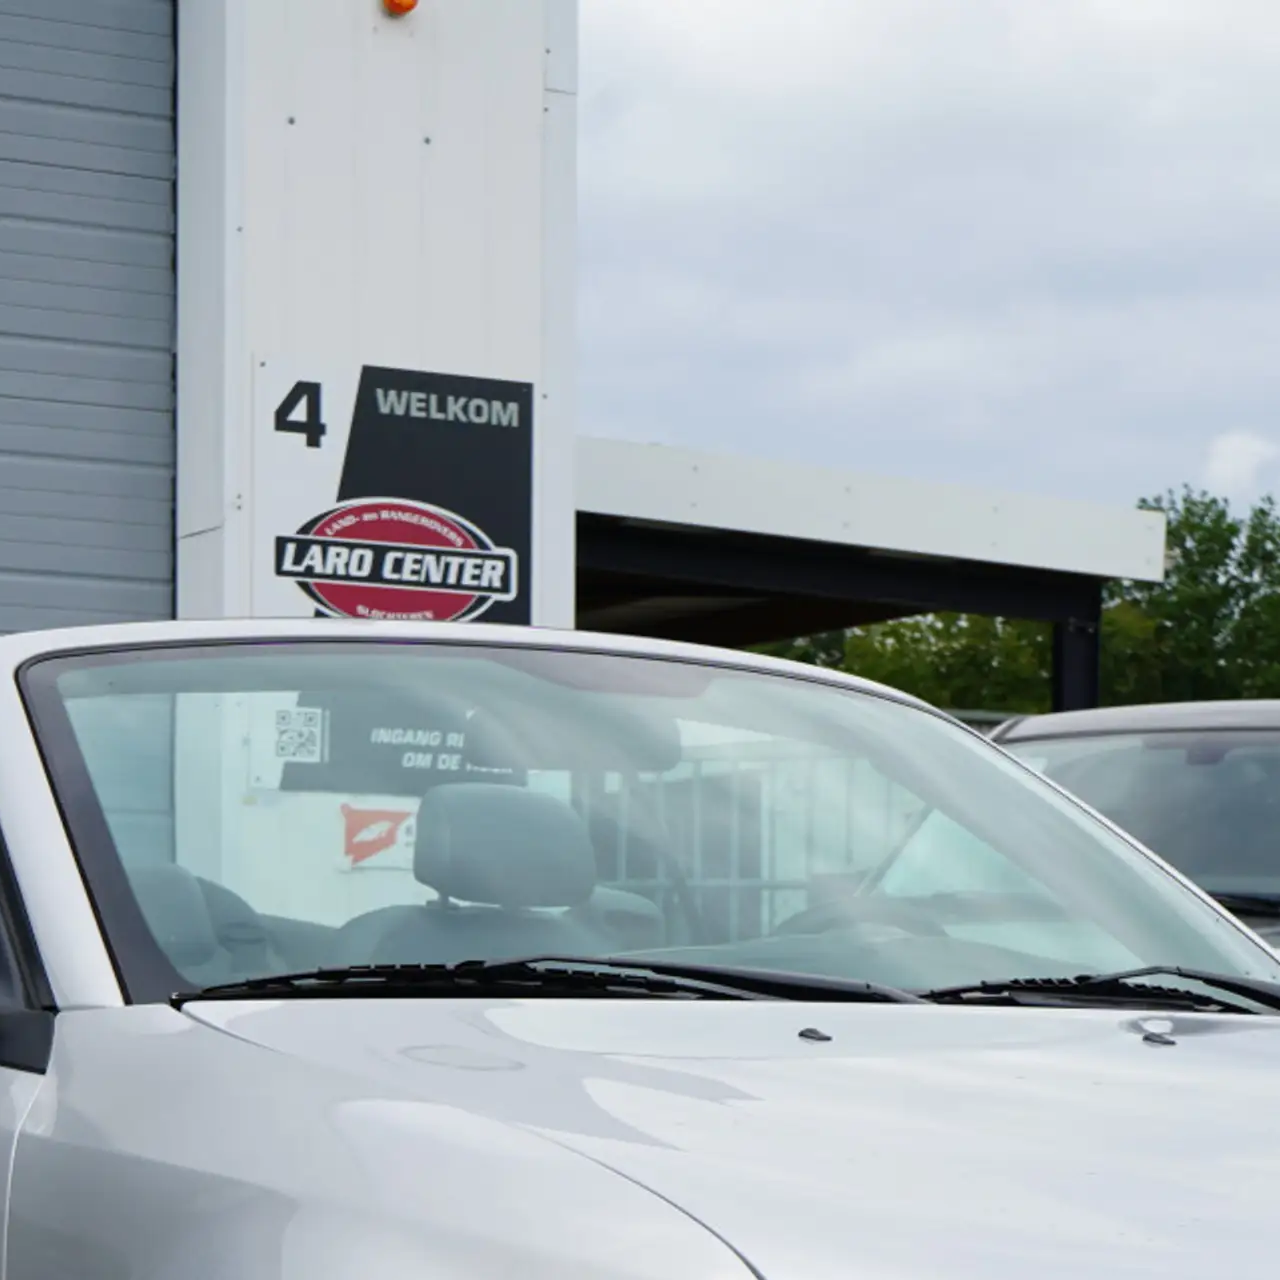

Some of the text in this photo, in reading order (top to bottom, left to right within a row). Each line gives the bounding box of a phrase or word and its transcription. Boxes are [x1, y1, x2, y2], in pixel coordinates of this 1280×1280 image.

[274, 380, 327, 449] 4
[375, 387, 519, 428] WELKOM
[281, 542, 505, 589] LARO CENTER
[371, 728, 442, 747] INGANG
[402, 752, 433, 769] OM
[437, 754, 462, 770] DE
